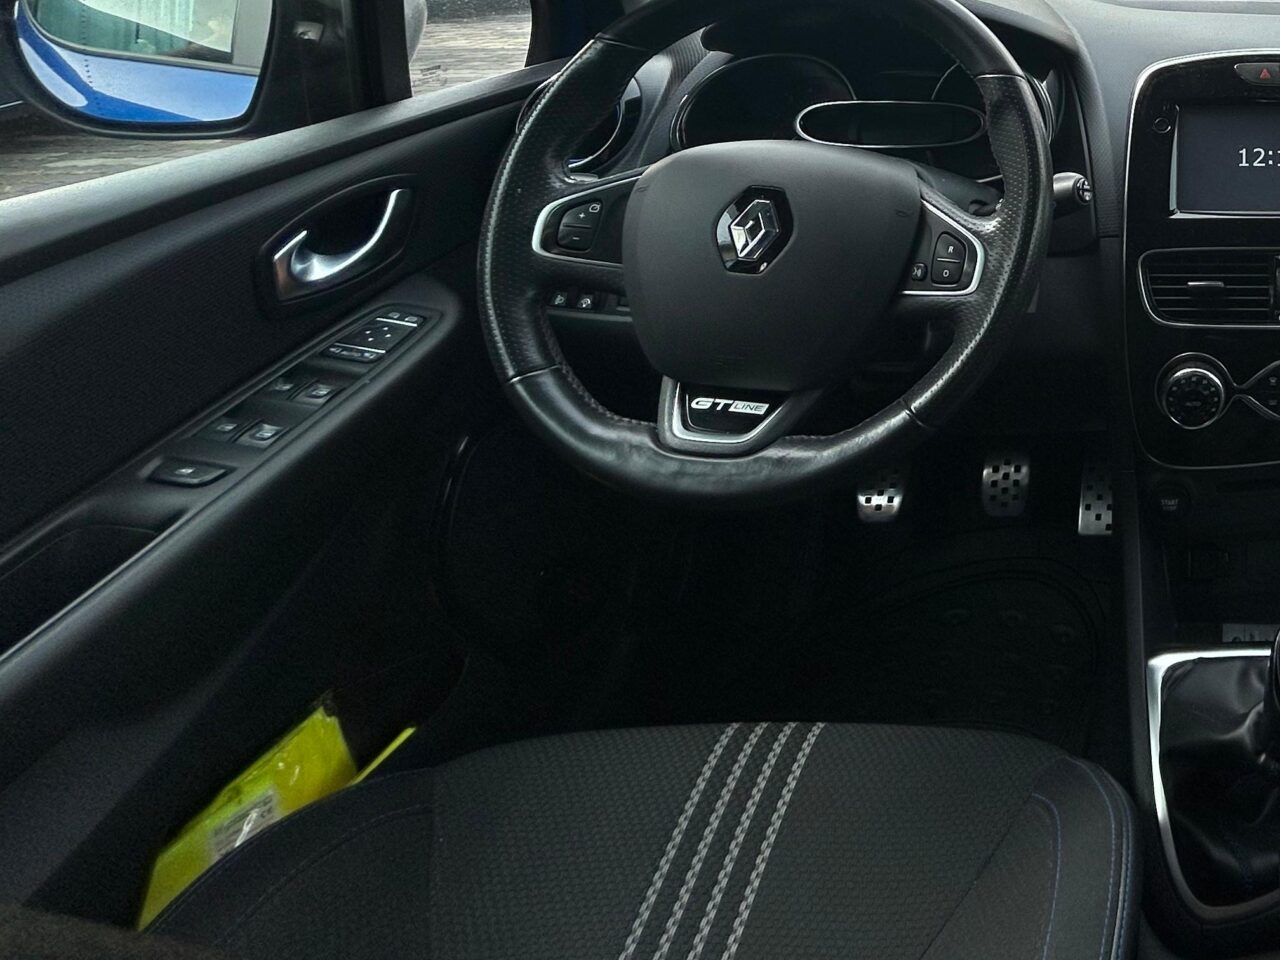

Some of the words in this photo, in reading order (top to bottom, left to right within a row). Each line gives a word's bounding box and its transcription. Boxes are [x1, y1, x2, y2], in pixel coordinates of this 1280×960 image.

[947, 246, 954, 254] R
[690, 397, 732, 411] GT
[731, 401, 768, 414] LINE
